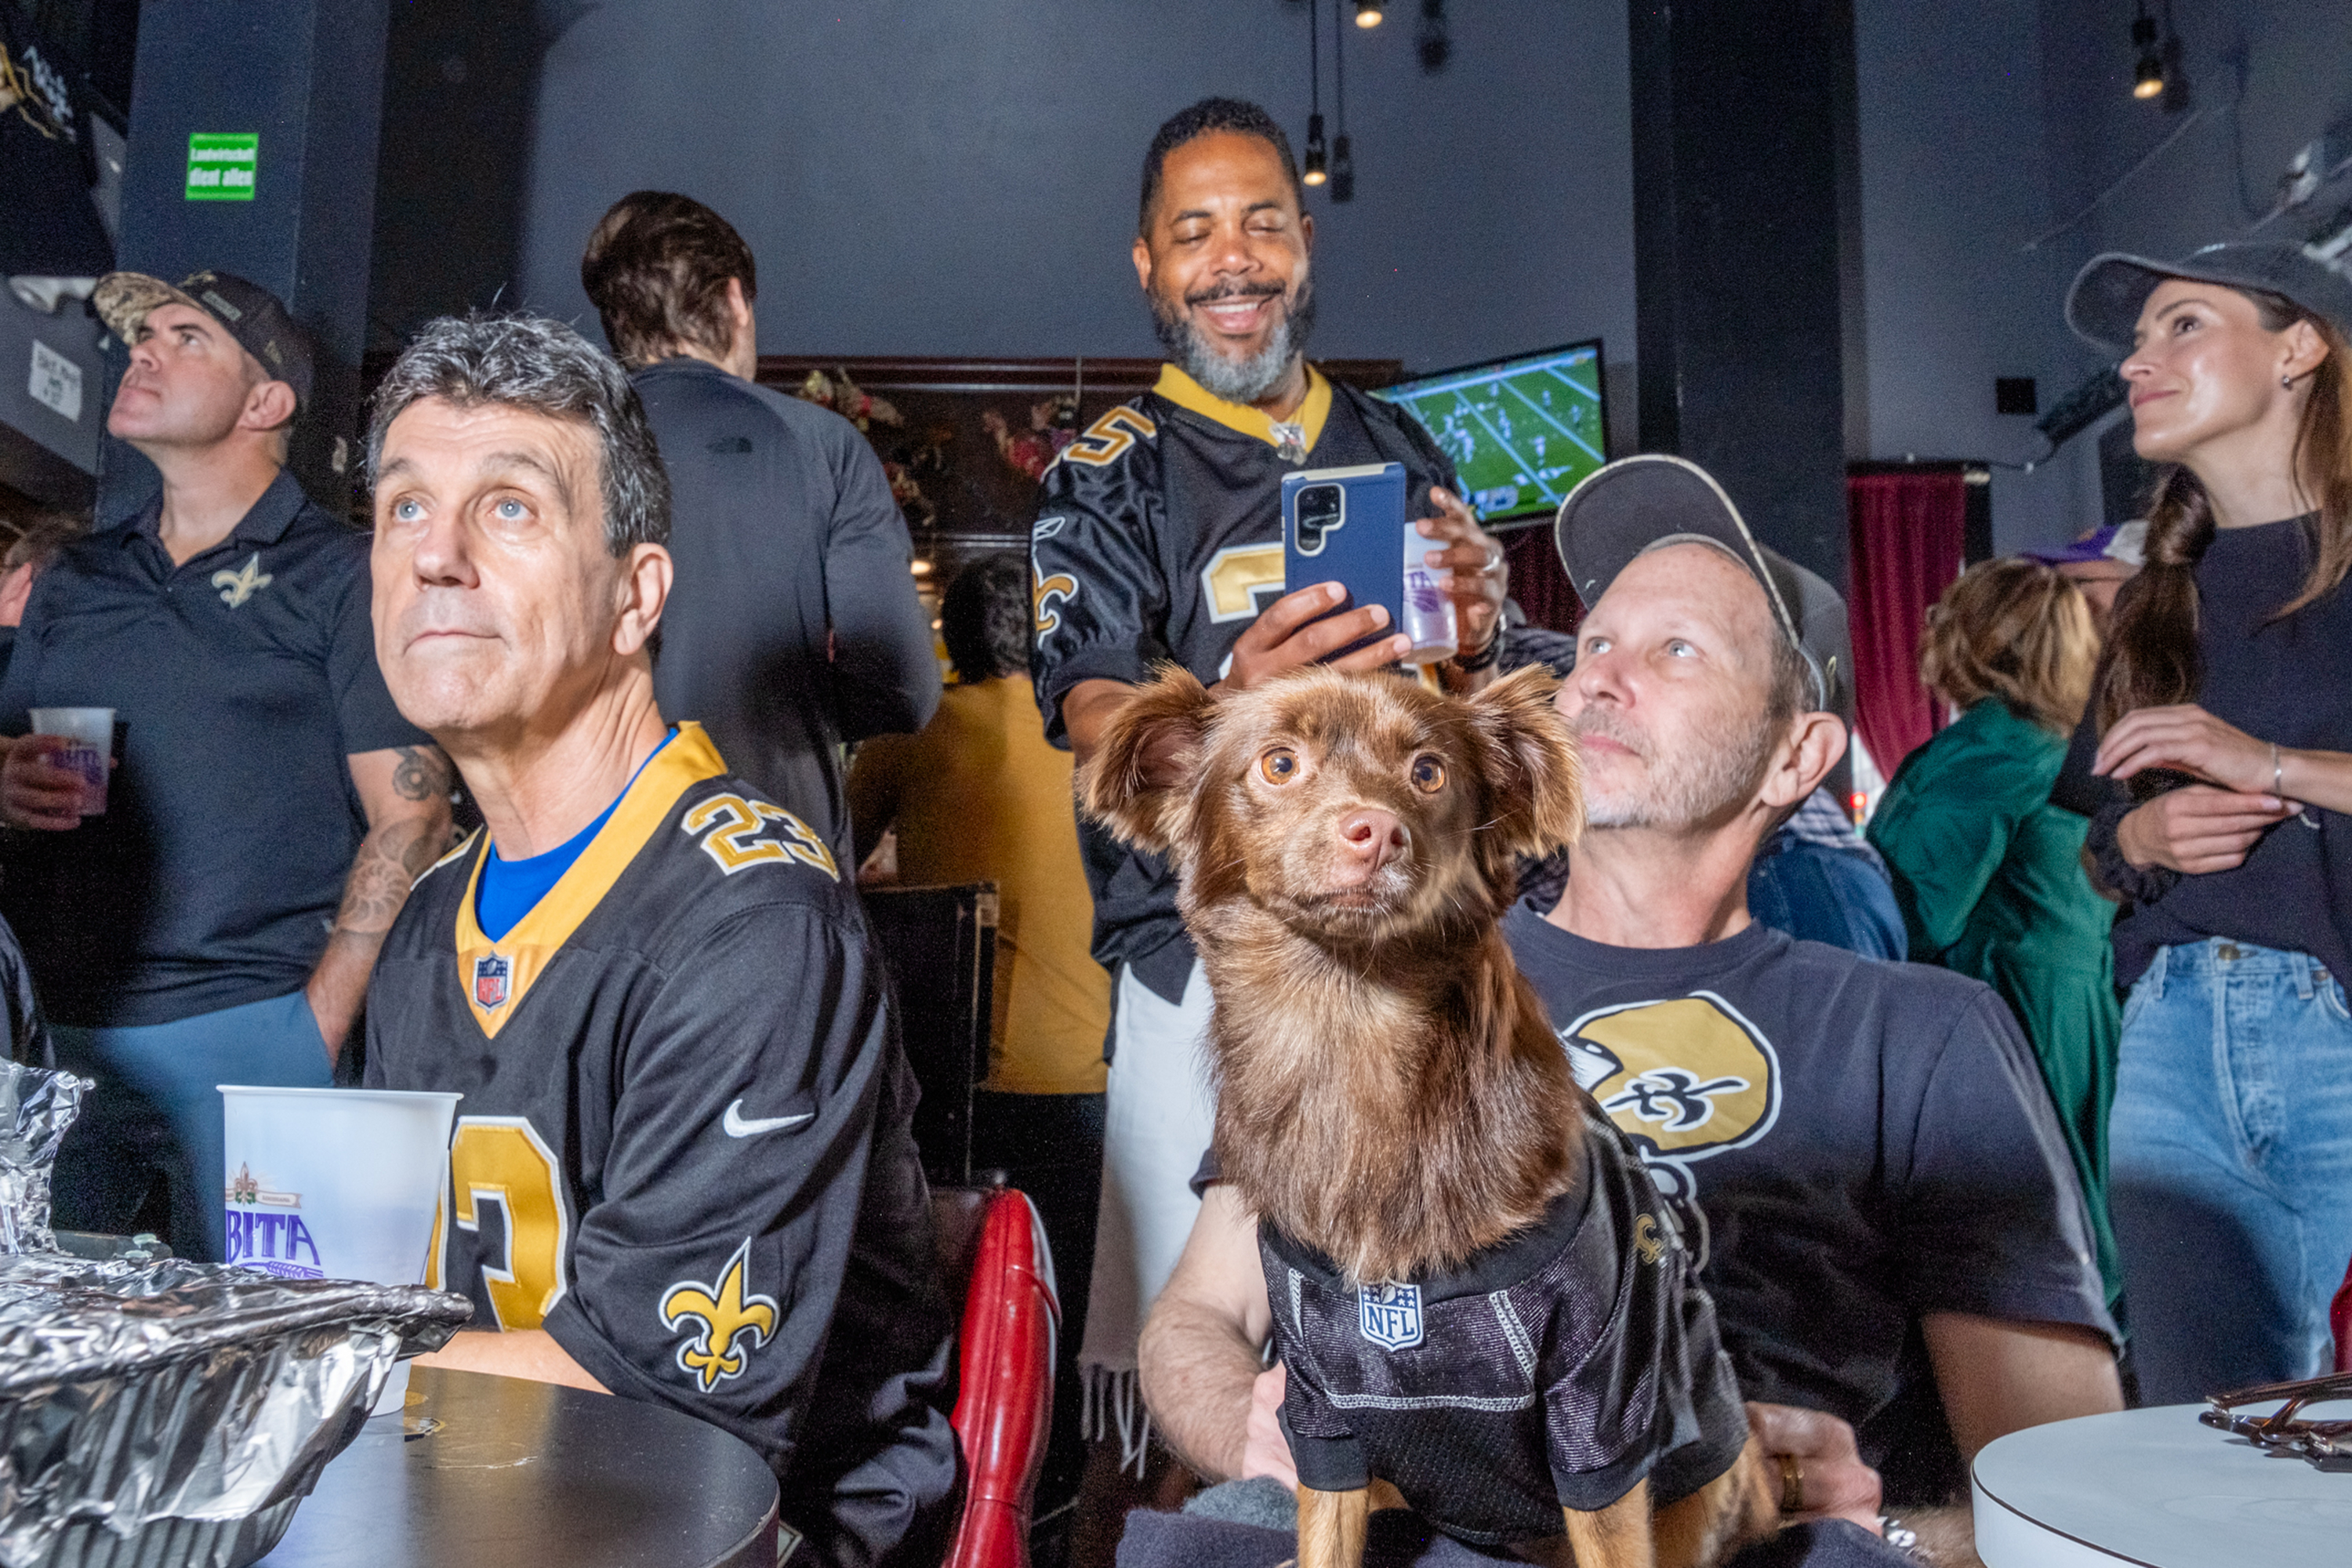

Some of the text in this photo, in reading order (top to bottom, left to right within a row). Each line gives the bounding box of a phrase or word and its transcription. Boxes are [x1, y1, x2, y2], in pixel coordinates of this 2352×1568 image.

[1040, 405, 1157, 480] 5
[681, 792, 840, 883] 23
[478, 977, 503, 1004] NFL
[426, 1116, 568, 1333] 3
[1367, 1305, 1415, 1340] NFL
